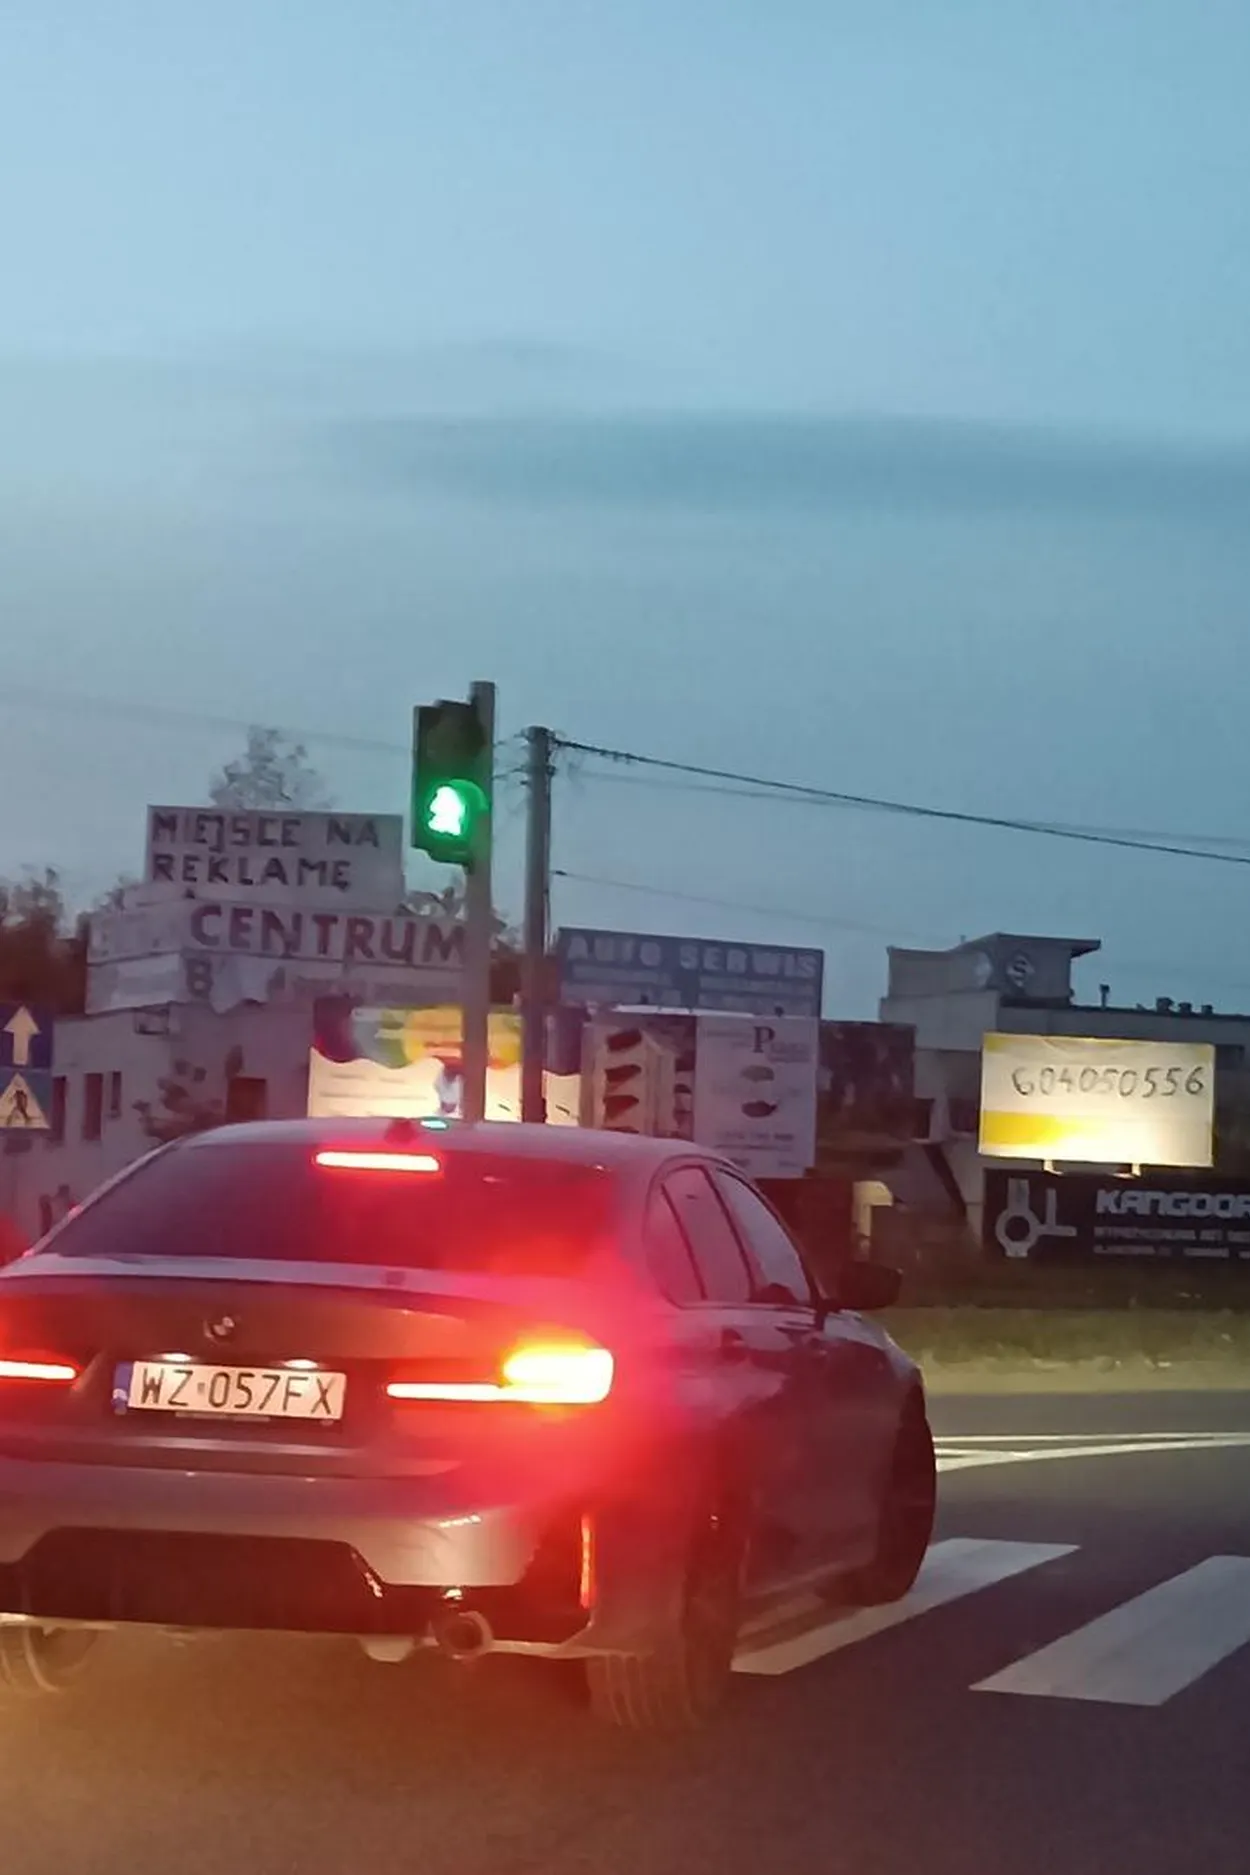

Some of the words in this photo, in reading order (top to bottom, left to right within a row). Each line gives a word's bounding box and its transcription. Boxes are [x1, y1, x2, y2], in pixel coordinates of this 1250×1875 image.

[152, 813, 301, 852] MIEJSCE
[326, 817, 380, 848] NA
[152, 852, 352, 890] REKLAMĘ
[190, 904, 466, 966] CENTRUM
[679, 945, 819, 978] SERWIS
[140, 1368, 194, 1407] WZ
[207, 1371, 336, 1416] 057FX
